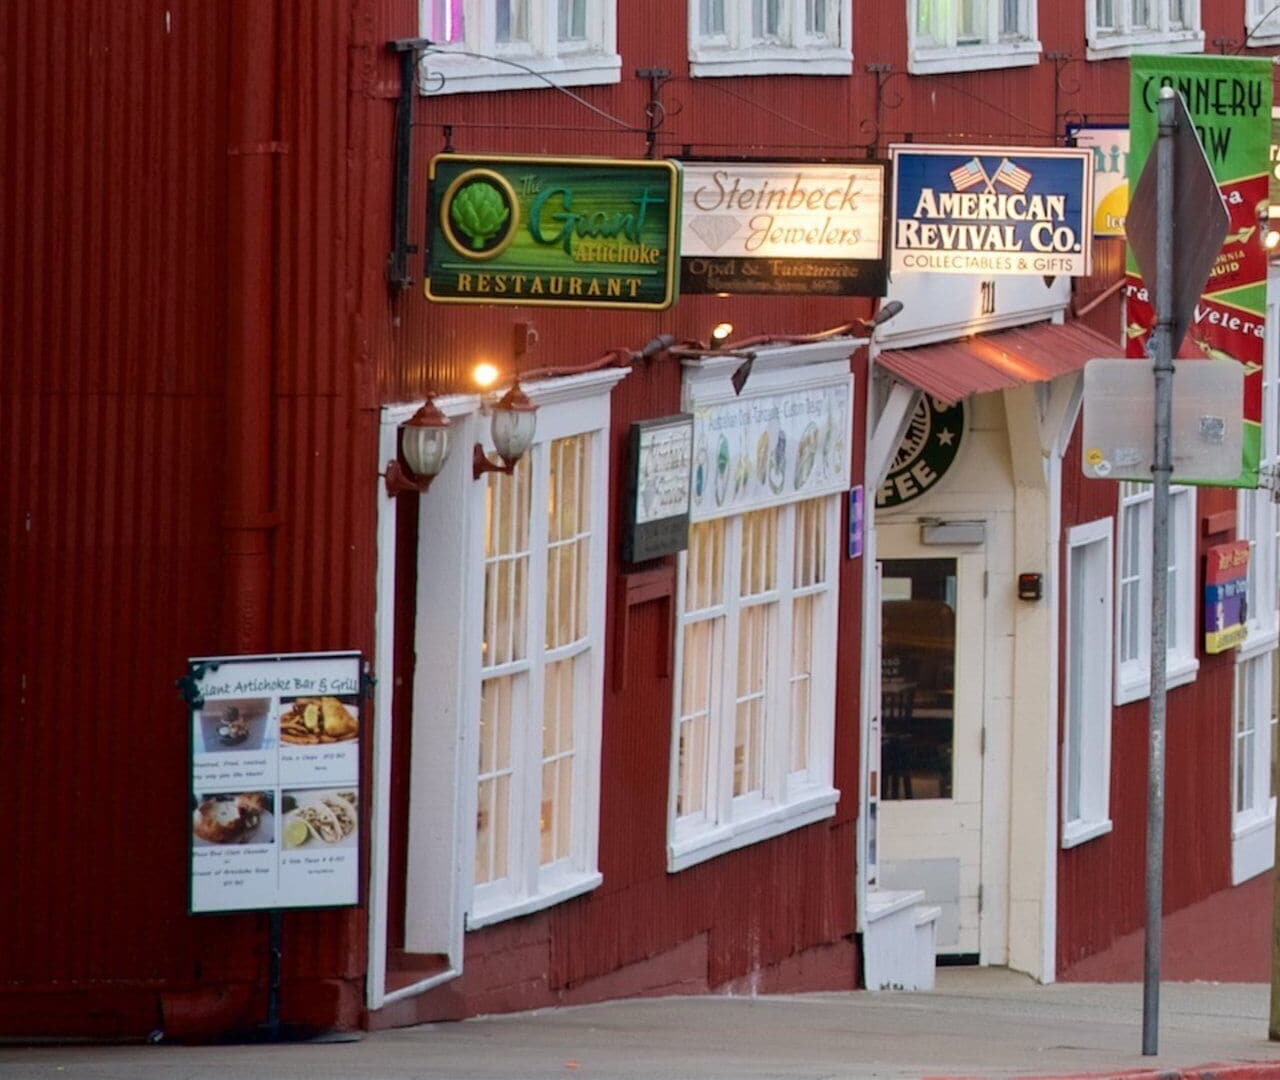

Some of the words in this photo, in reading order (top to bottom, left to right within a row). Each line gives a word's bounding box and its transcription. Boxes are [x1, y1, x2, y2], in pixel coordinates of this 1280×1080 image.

[693, 170, 864, 212] Steinbeck
[913, 188, 1066, 221] AMERICAN
[529, 186, 665, 255] Giant
[744, 214, 863, 252] Jewelers
[897, 218, 1023, 251] REVIVAL
[1030, 221, 1082, 252] CO.
[903, 254, 1012, 270] COLLECTABLES
[1017, 258, 1028, 270] &
[1033, 258, 1074, 271] GIFTS
[457, 273, 643, 297] RESTAURANT
[234, 678, 291, 693] Artichoke
[294, 677, 316, 690] Bar
